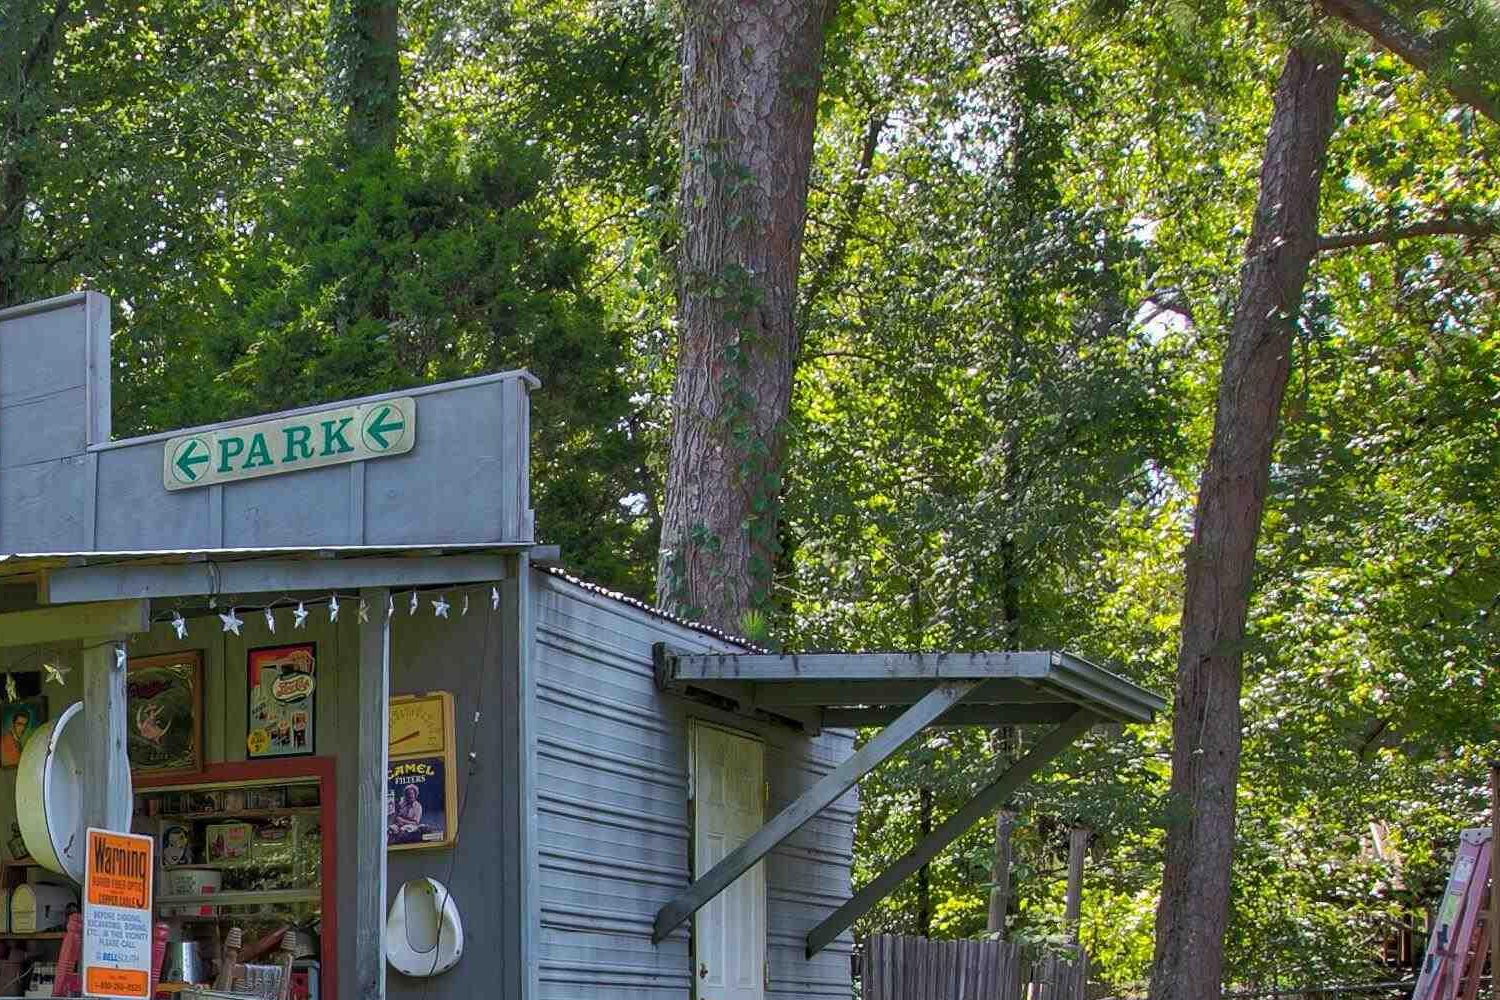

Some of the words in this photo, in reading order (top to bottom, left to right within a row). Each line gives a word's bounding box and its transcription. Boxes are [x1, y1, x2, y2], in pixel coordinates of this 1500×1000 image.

[217, 416, 355, 473] PARK
[395, 775, 426, 785] FILTERS
[94, 836, 147, 908] Warning
